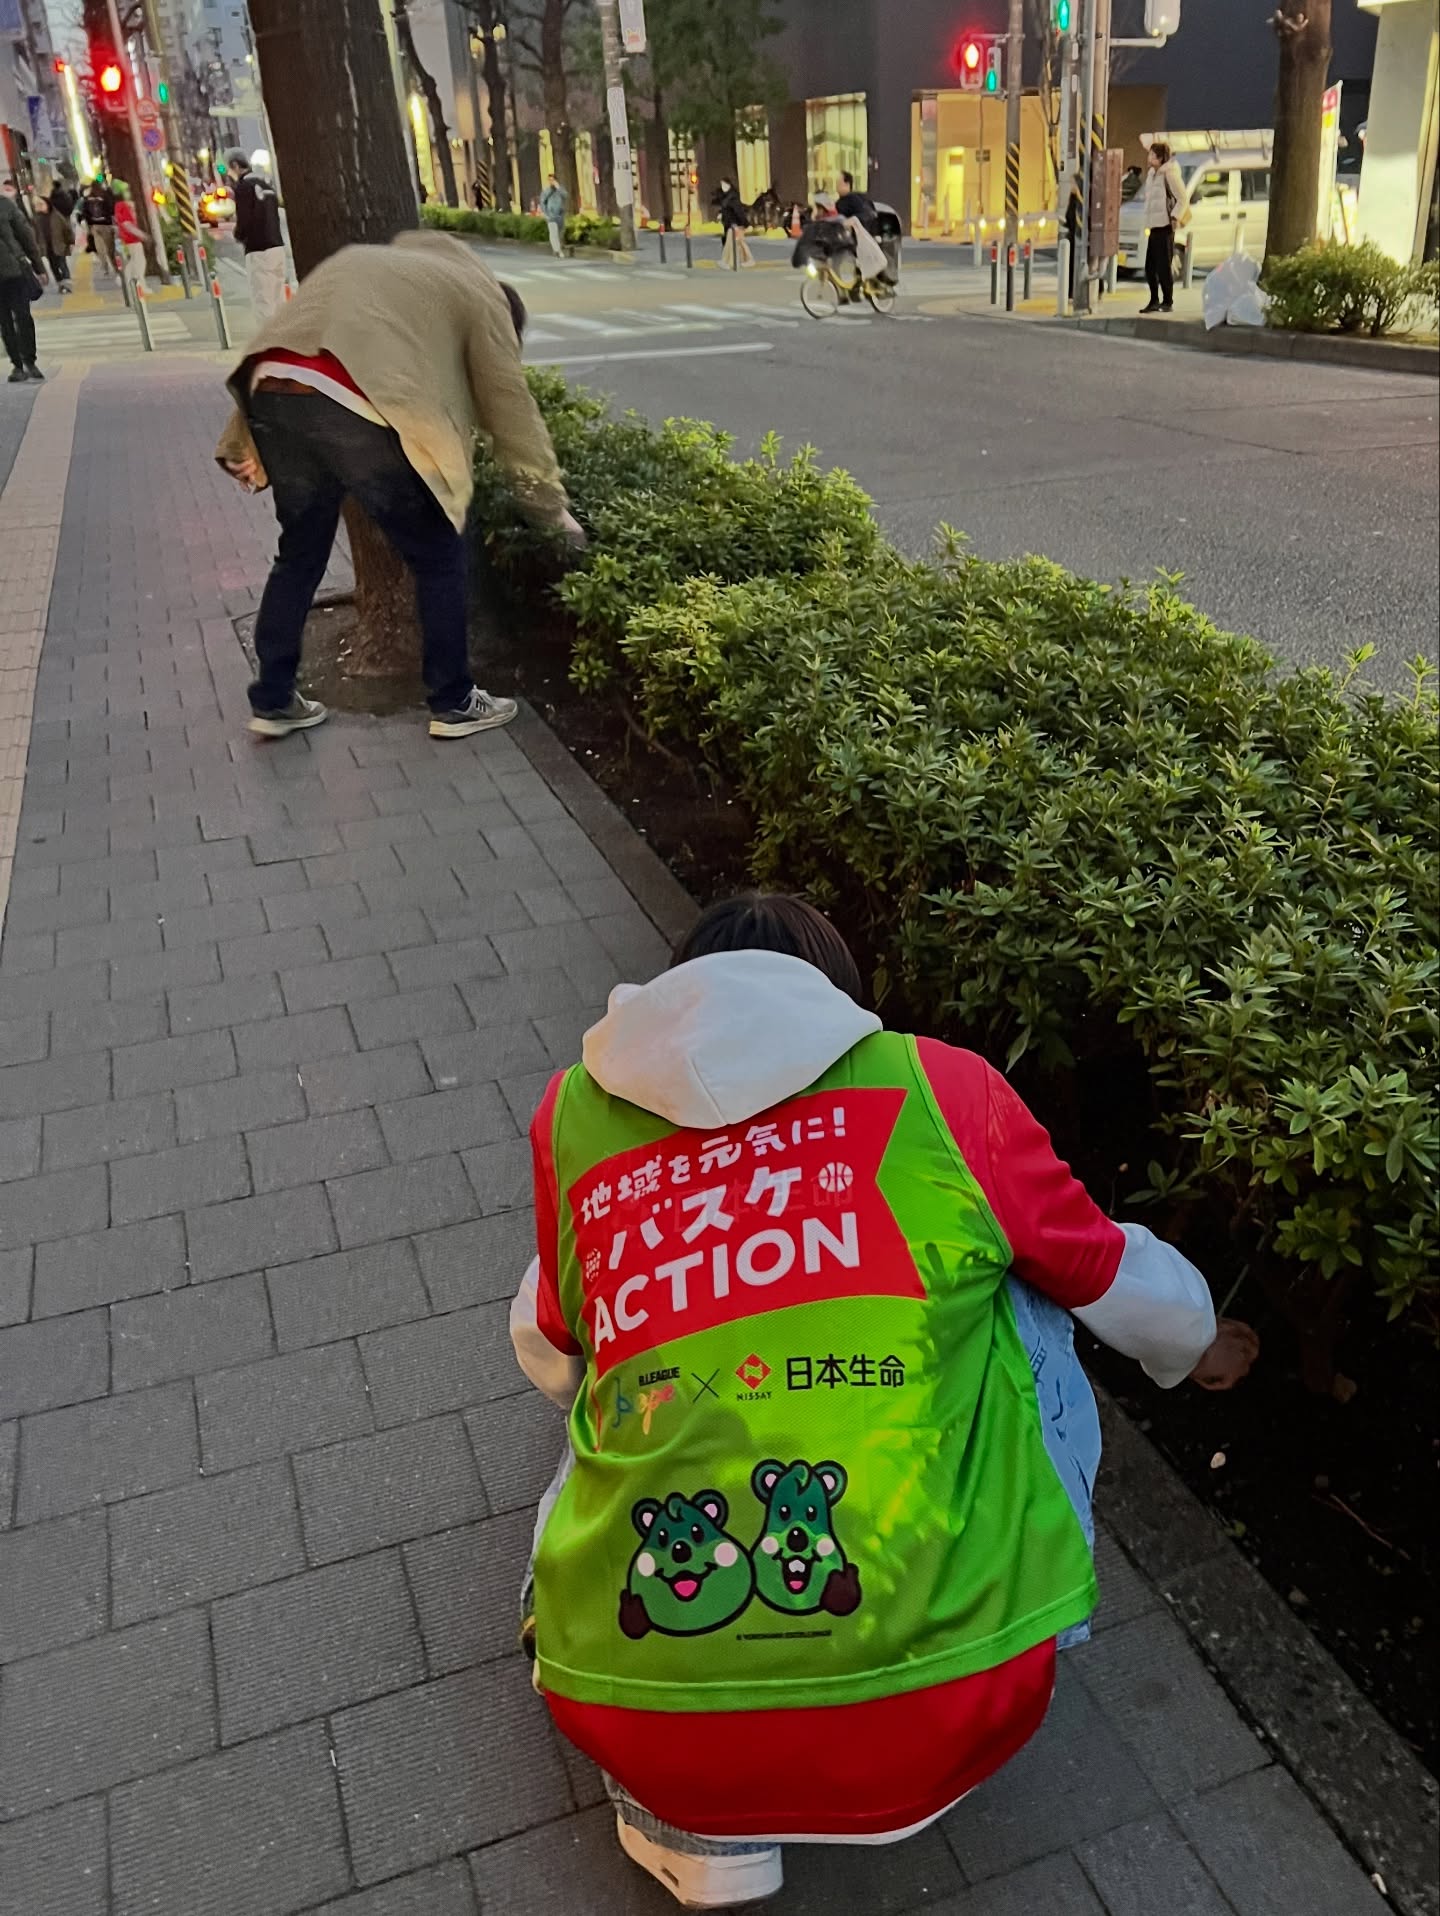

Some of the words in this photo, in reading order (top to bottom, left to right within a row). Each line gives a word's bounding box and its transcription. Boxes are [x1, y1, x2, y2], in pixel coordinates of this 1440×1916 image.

[608, 1166, 802, 1269] バスケ
[594, 1211, 860, 1353] ACTION
[786, 1353, 905, 1391] 日本生命
